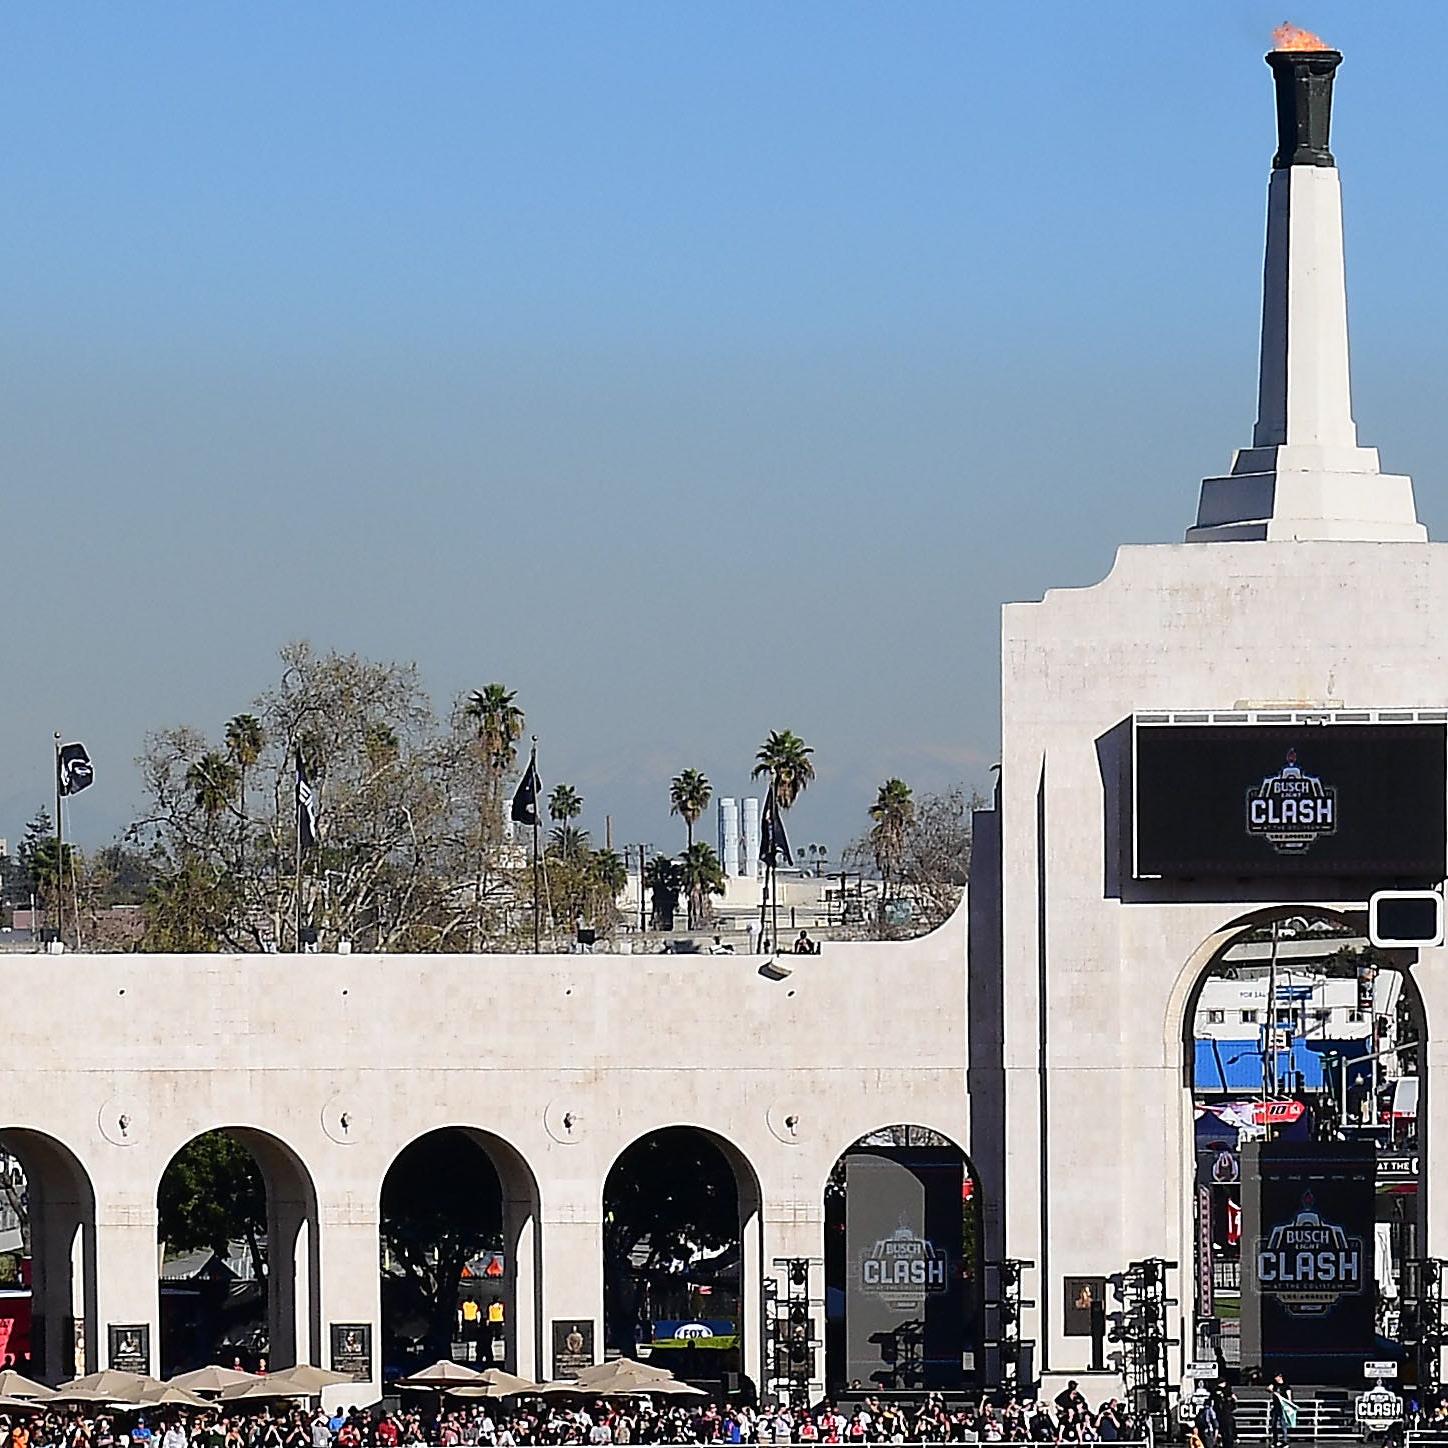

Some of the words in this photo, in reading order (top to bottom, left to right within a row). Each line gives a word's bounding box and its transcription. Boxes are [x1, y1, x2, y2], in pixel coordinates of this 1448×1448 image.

[1274, 781, 1309, 794] BUSCH
[1251, 799, 1332, 823] CLASH
[1376, 1162, 1389, 1170] AT
[1391, 1162, 1410, 1170] THE
[1287, 1230, 1329, 1244] BUSCH
[886, 1243, 921, 1254] BUSCH
[864, 1260, 943, 1283] CLASH
[1258, 1252, 1357, 1280] CLASH
[683, 1329, 703, 1338] FOX
[1358, 1402, 1401, 1416] CLASH
